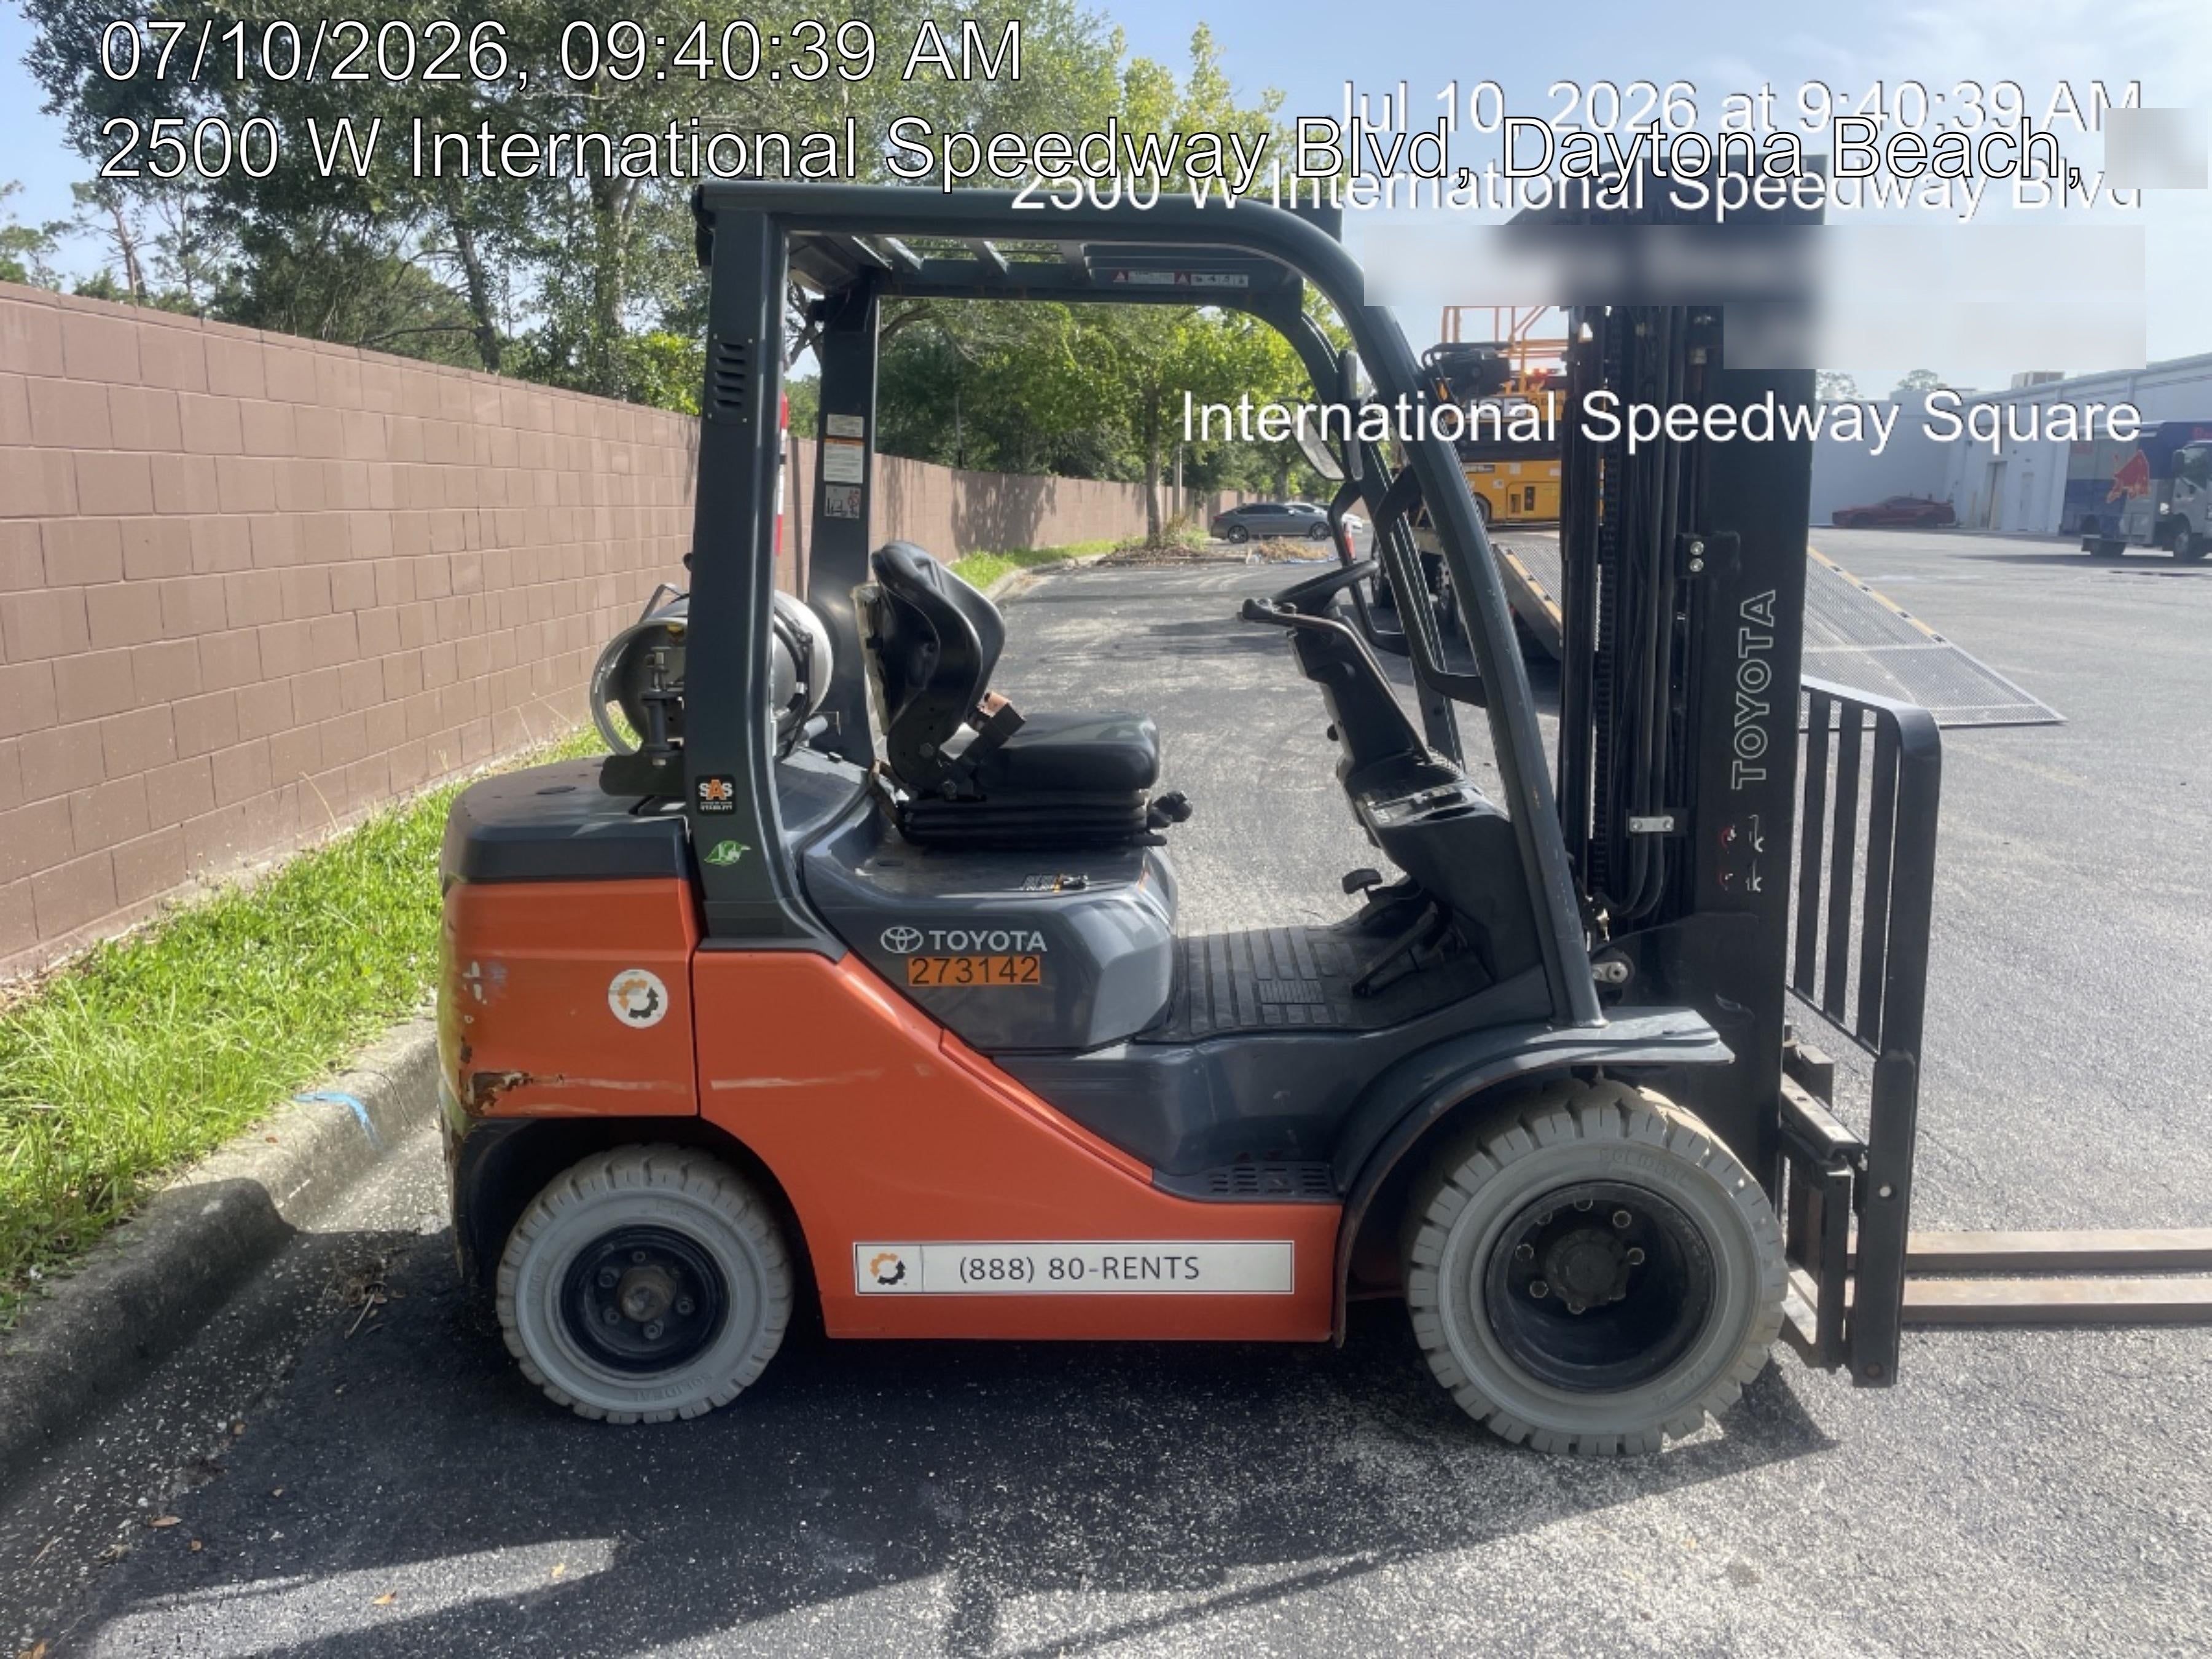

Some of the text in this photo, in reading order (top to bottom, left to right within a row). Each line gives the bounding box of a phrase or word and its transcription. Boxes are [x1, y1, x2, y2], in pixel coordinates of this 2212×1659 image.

[1730, 589, 1776, 790] TOYOTA
[699, 779, 733, 800] SAS
[928, 930, 1048, 952] TOYOTA
[912, 956, 1038, 984] 273142
[959, 1257, 1200, 1284] (888) 80-RENTS
